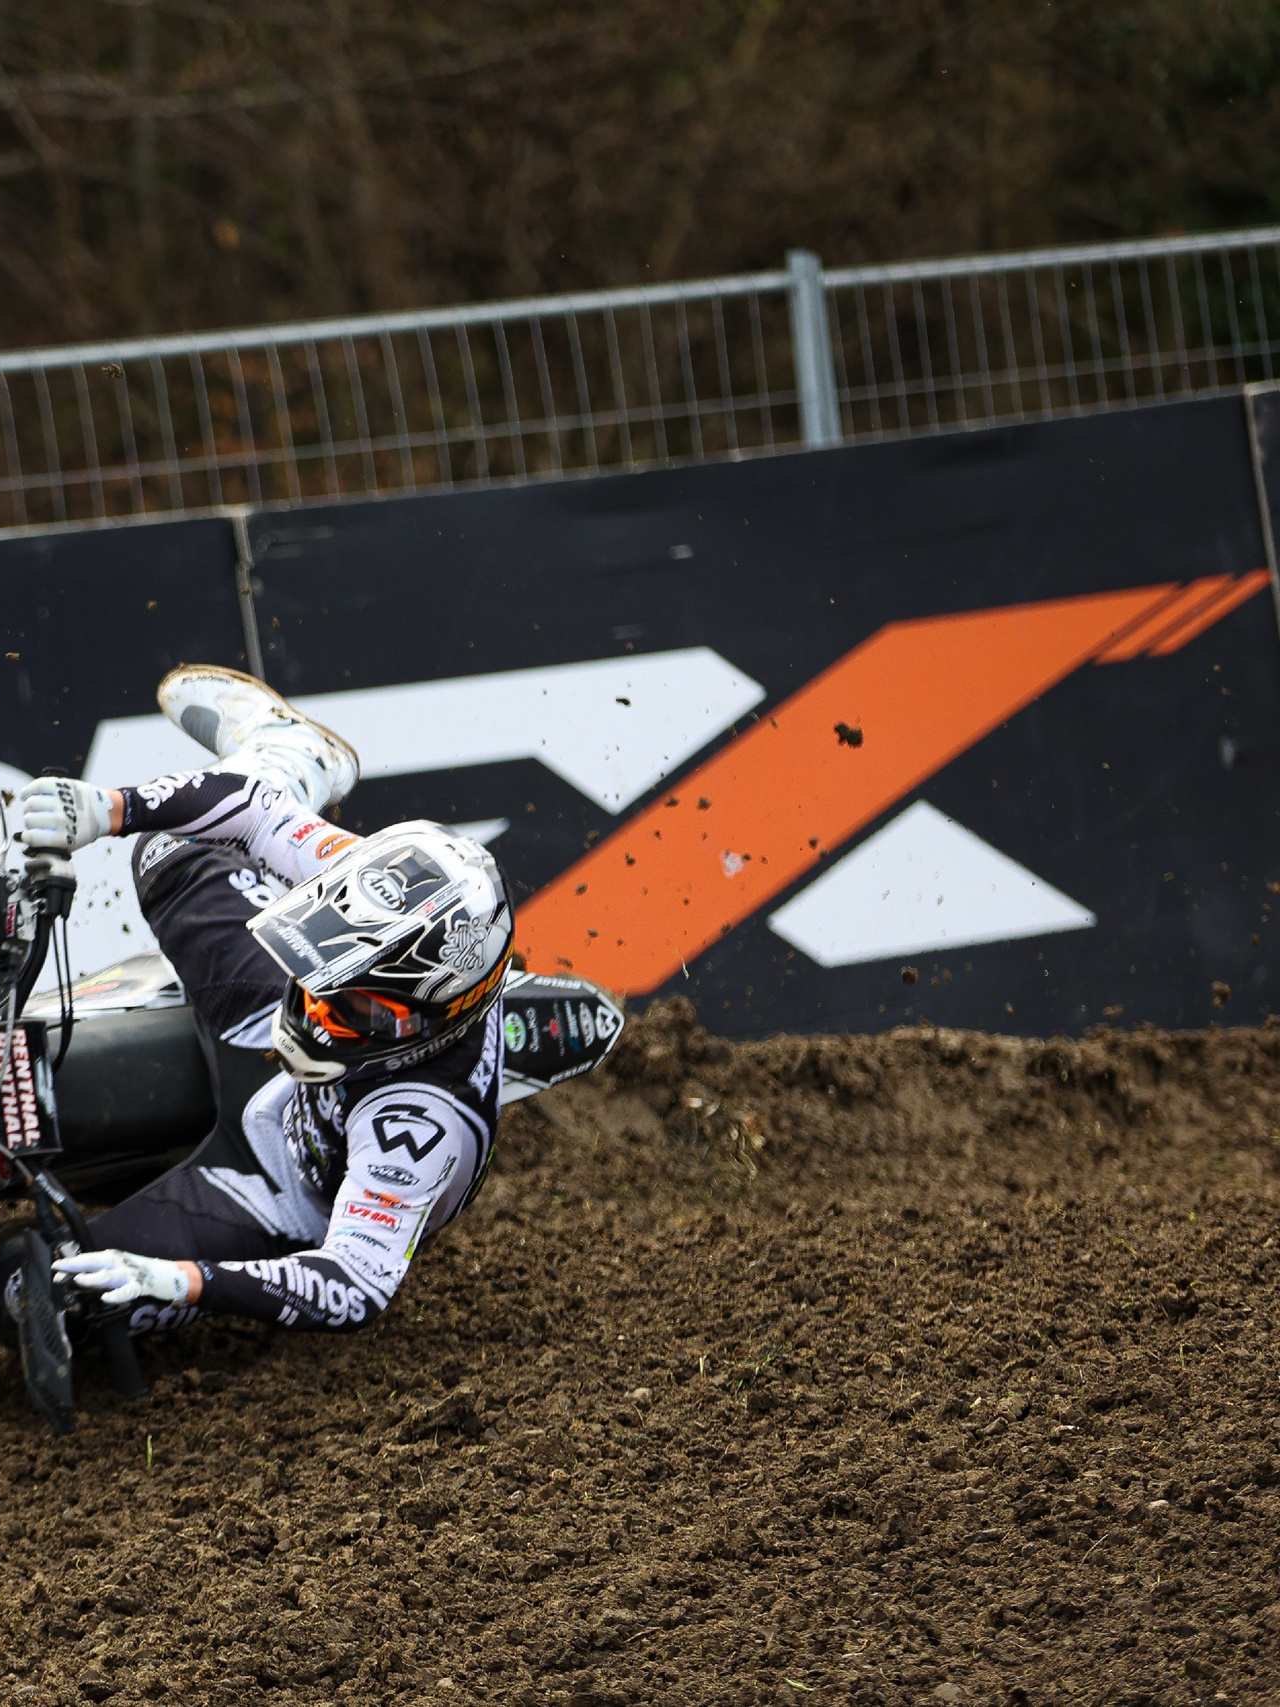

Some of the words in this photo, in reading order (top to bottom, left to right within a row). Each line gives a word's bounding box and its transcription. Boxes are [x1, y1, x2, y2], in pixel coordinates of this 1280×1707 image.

[365, 872, 400, 907] Arai
[10, 1028, 42, 1148] RENTHAL
[347, 1204, 398, 1229] VHM
